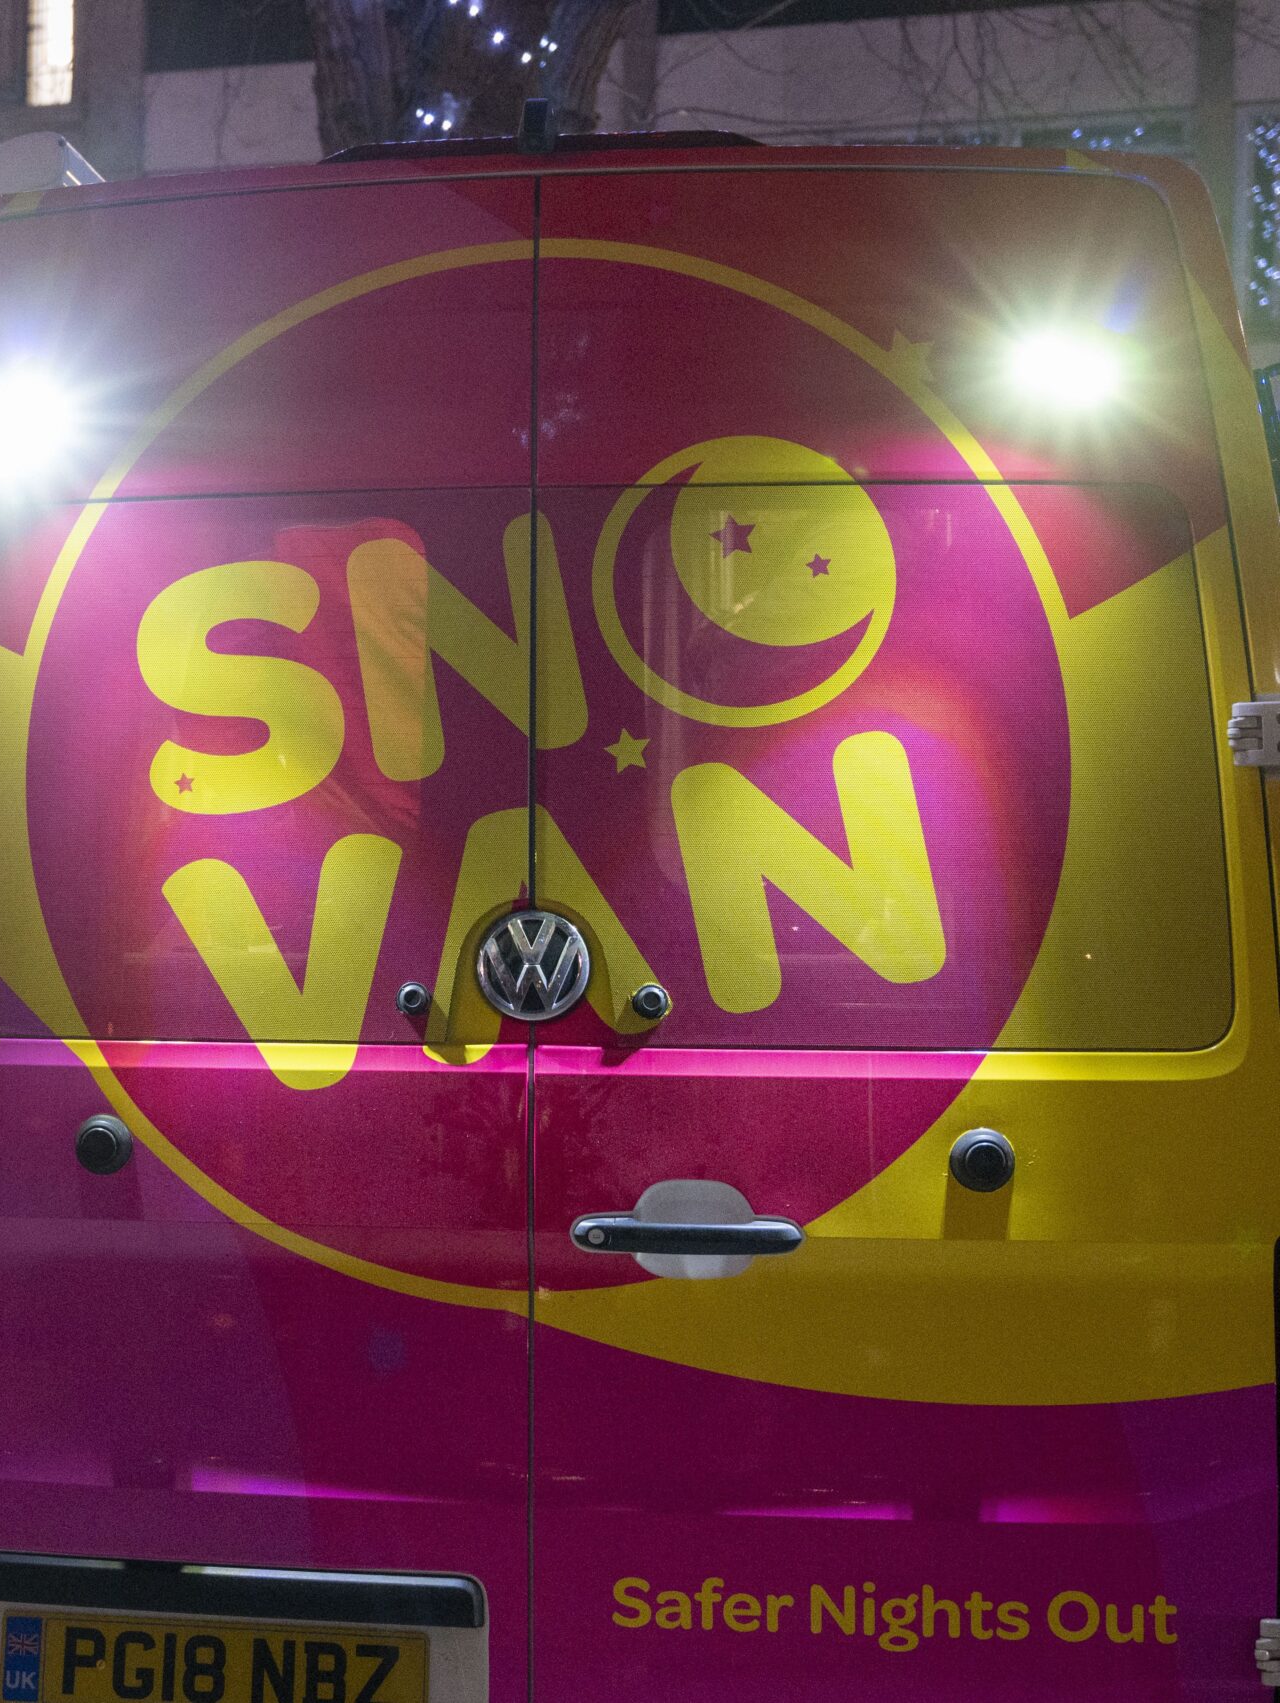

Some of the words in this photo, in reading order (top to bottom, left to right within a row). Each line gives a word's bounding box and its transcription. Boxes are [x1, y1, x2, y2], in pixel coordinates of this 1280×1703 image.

[161, 730, 947, 1091] VAN
[484, 915, 585, 1012] VW
[612, 1576, 794, 1633] Safer
[810, 1581, 1031, 1652] Nights
[1046, 1590, 1178, 1644] Out
[6, 1671, 36, 1690] UK
[62, 1626, 227, 1703] PG18
[251, 1638, 400, 1703] NBZ
